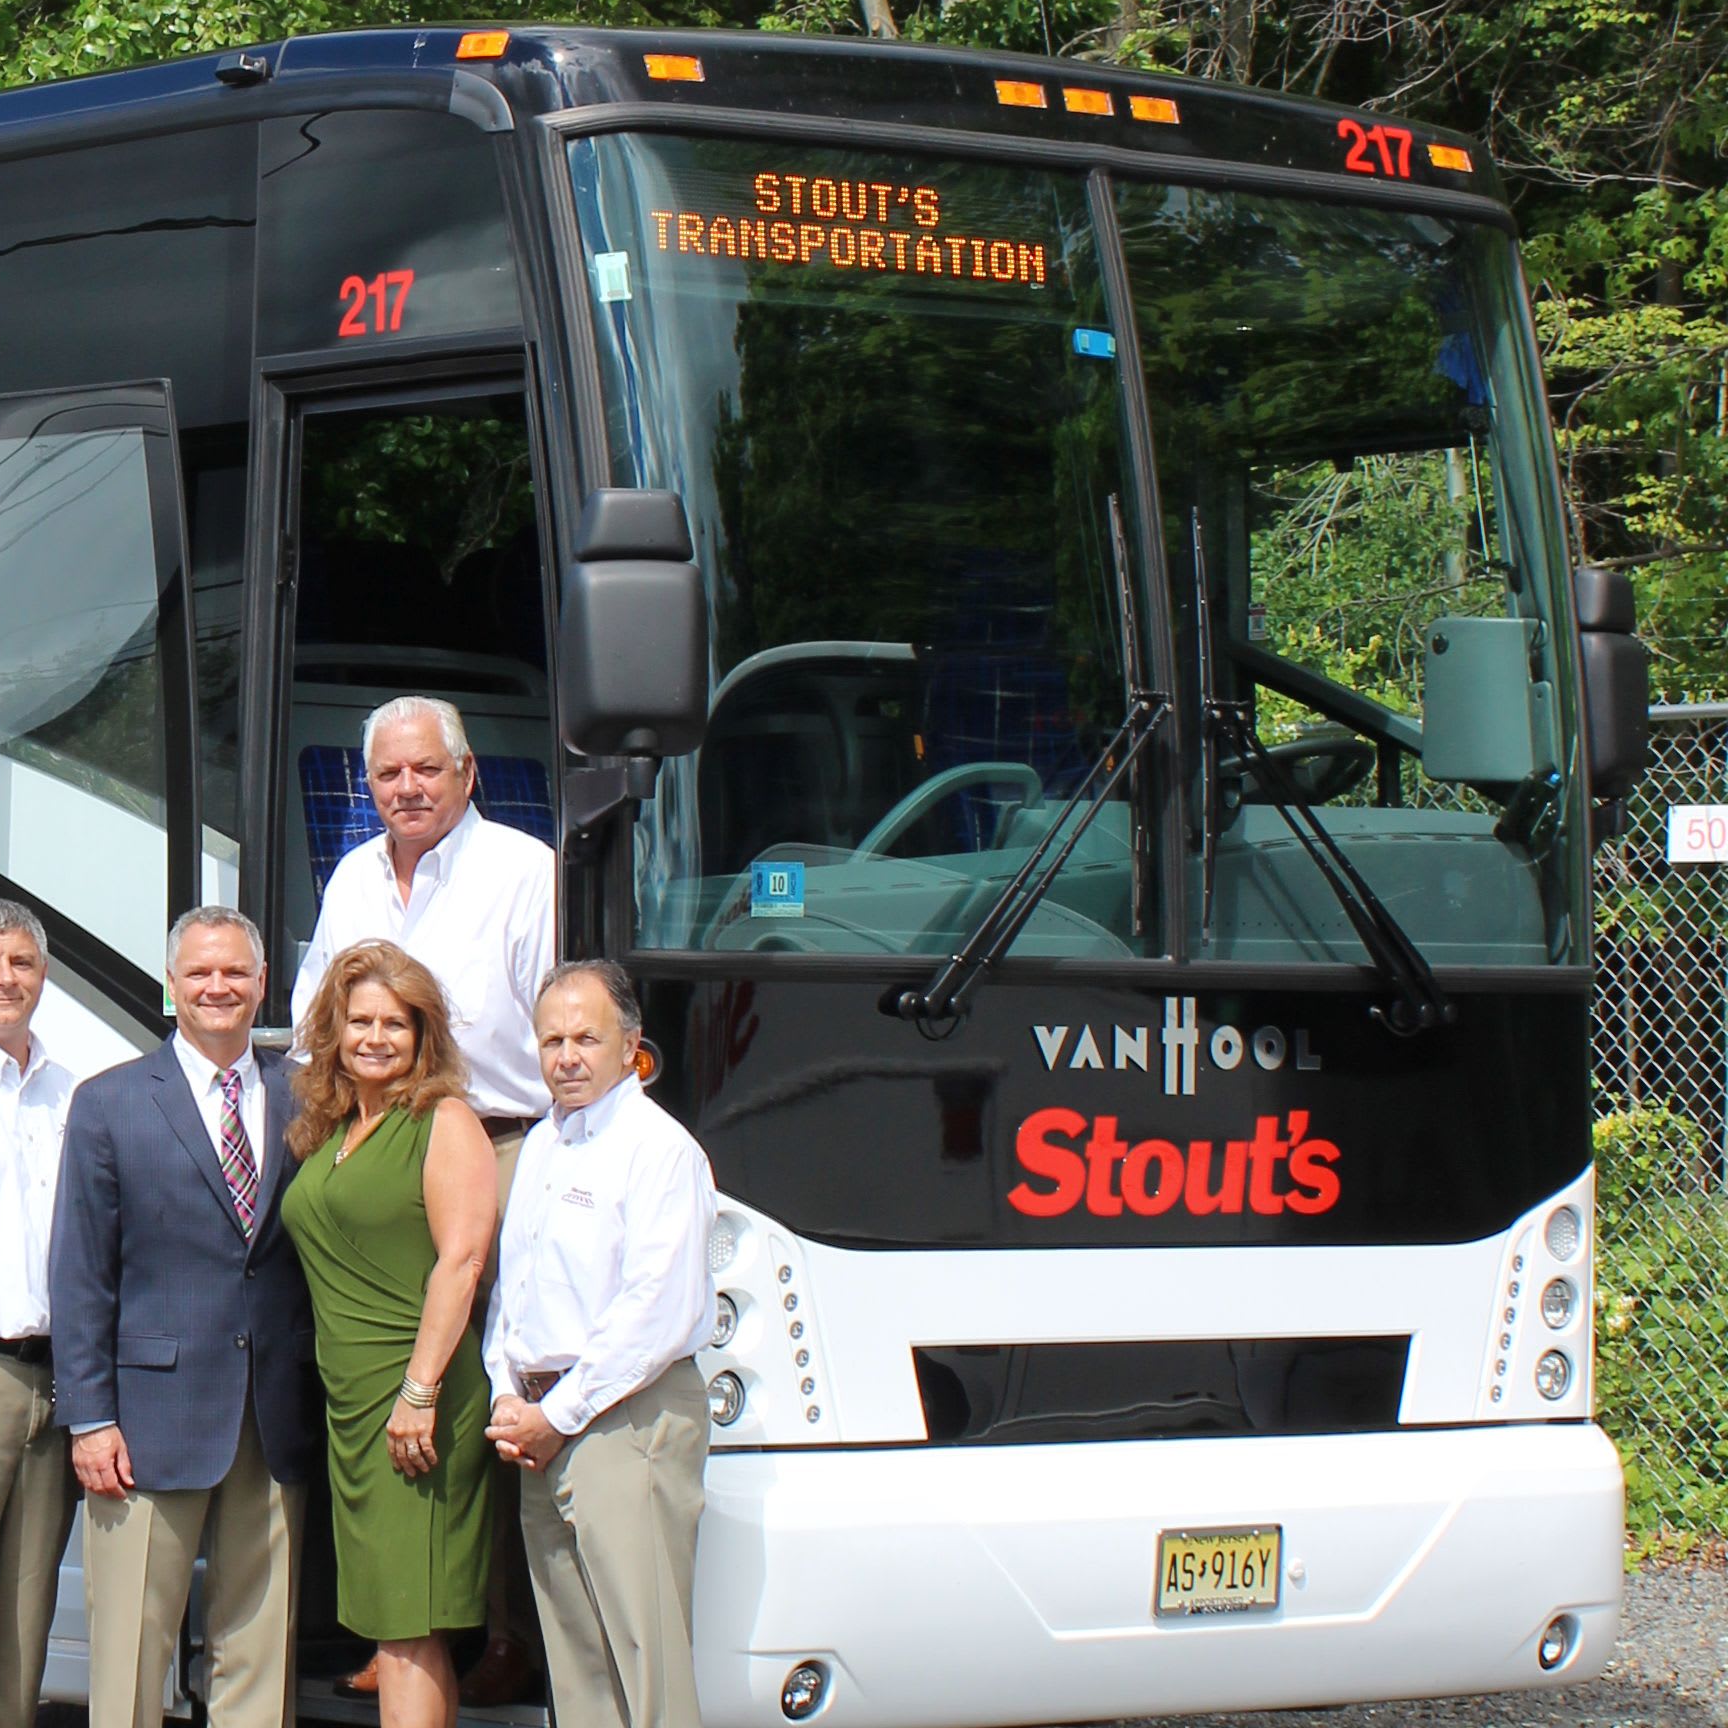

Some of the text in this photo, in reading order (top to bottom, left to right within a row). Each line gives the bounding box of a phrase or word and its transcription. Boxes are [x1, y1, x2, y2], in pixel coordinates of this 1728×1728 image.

[1337, 118, 1413, 179] 217
[754, 172, 940, 227] STOUT'S
[651, 190, 1046, 283] TRANSPORTATION
[338, 268, 415, 338] 217
[1007, 1107, 1342, 1217] Stout's
